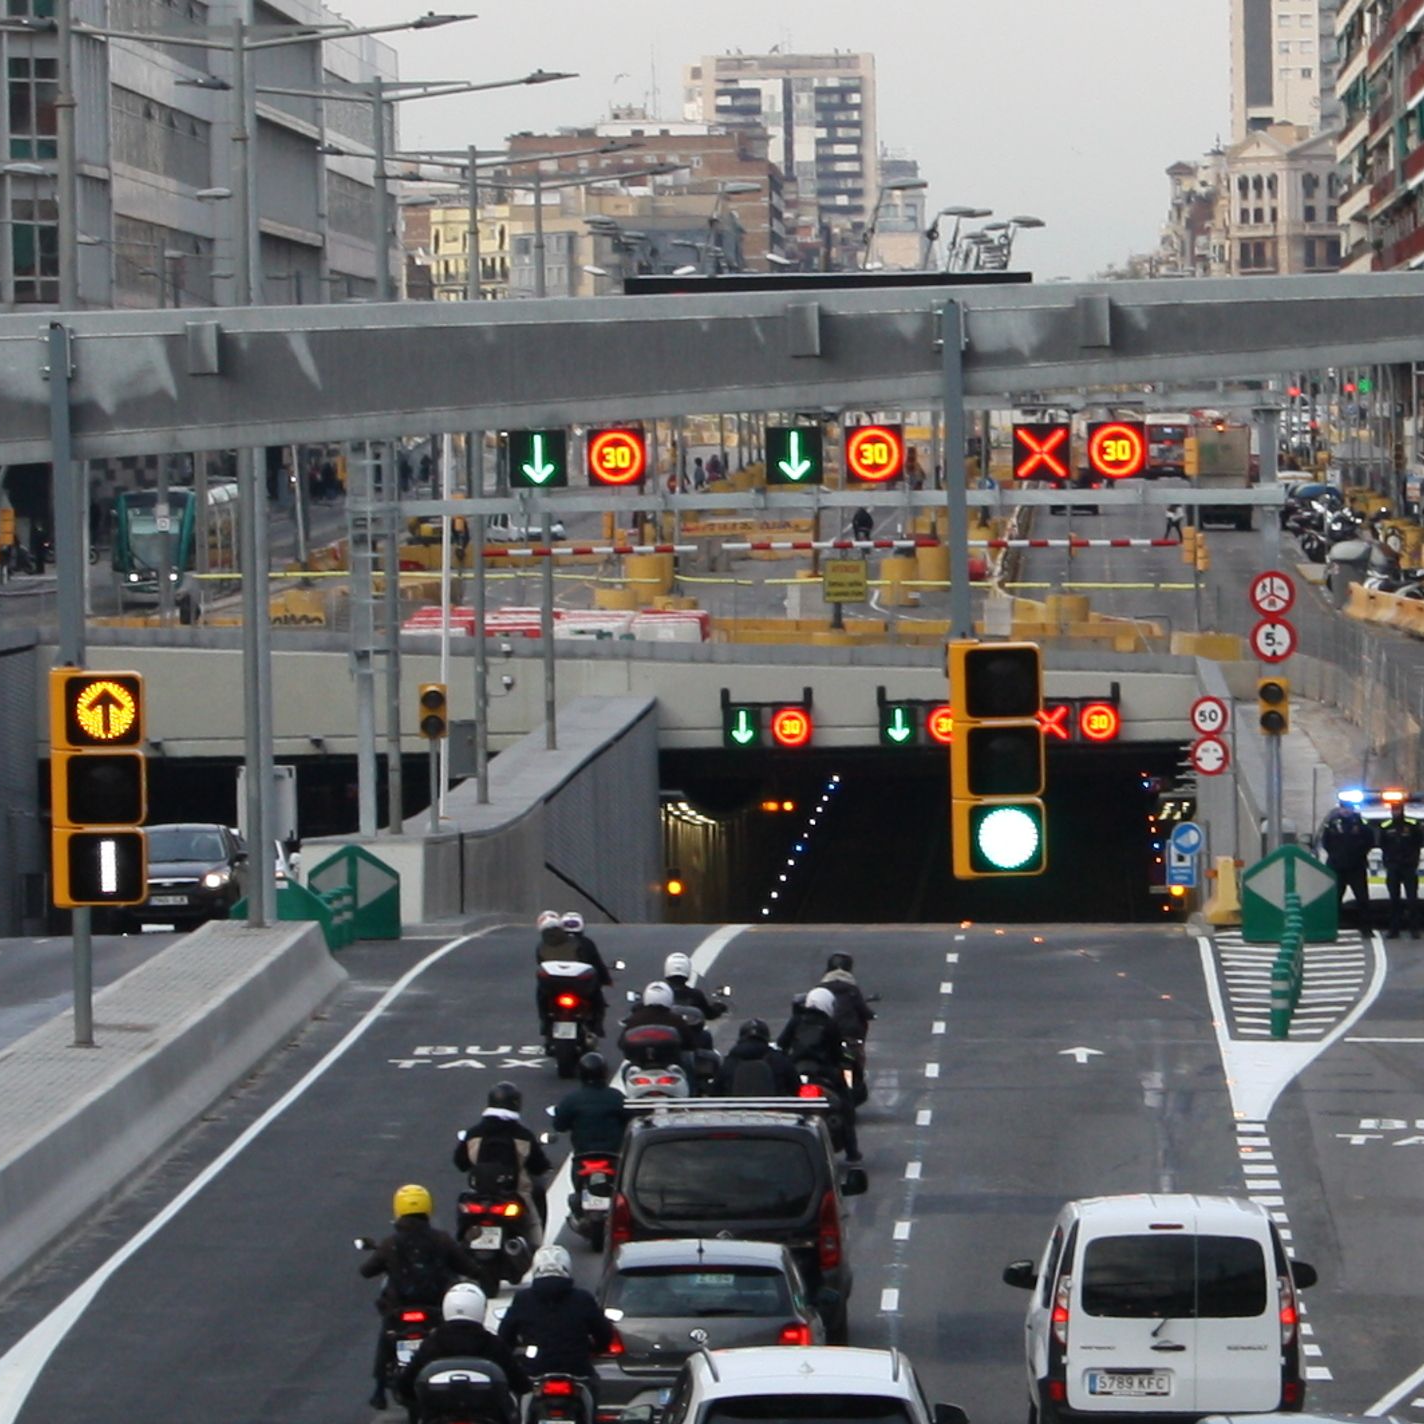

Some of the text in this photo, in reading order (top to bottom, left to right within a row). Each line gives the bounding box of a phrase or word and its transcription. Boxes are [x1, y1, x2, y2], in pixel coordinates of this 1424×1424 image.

[860, 443, 887, 465] 30
[1102, 440, 1130, 461] 30
[602, 447, 630, 469] 30
[1090, 715, 1108, 729] 30
[1198, 709, 1219, 722] 50
[782, 720, 802, 735] 30
[413, 1045, 546, 1055] BUS
[387, 1058, 551, 1069] TAX
[1099, 1376, 1165, 1390] 5789 KFC
